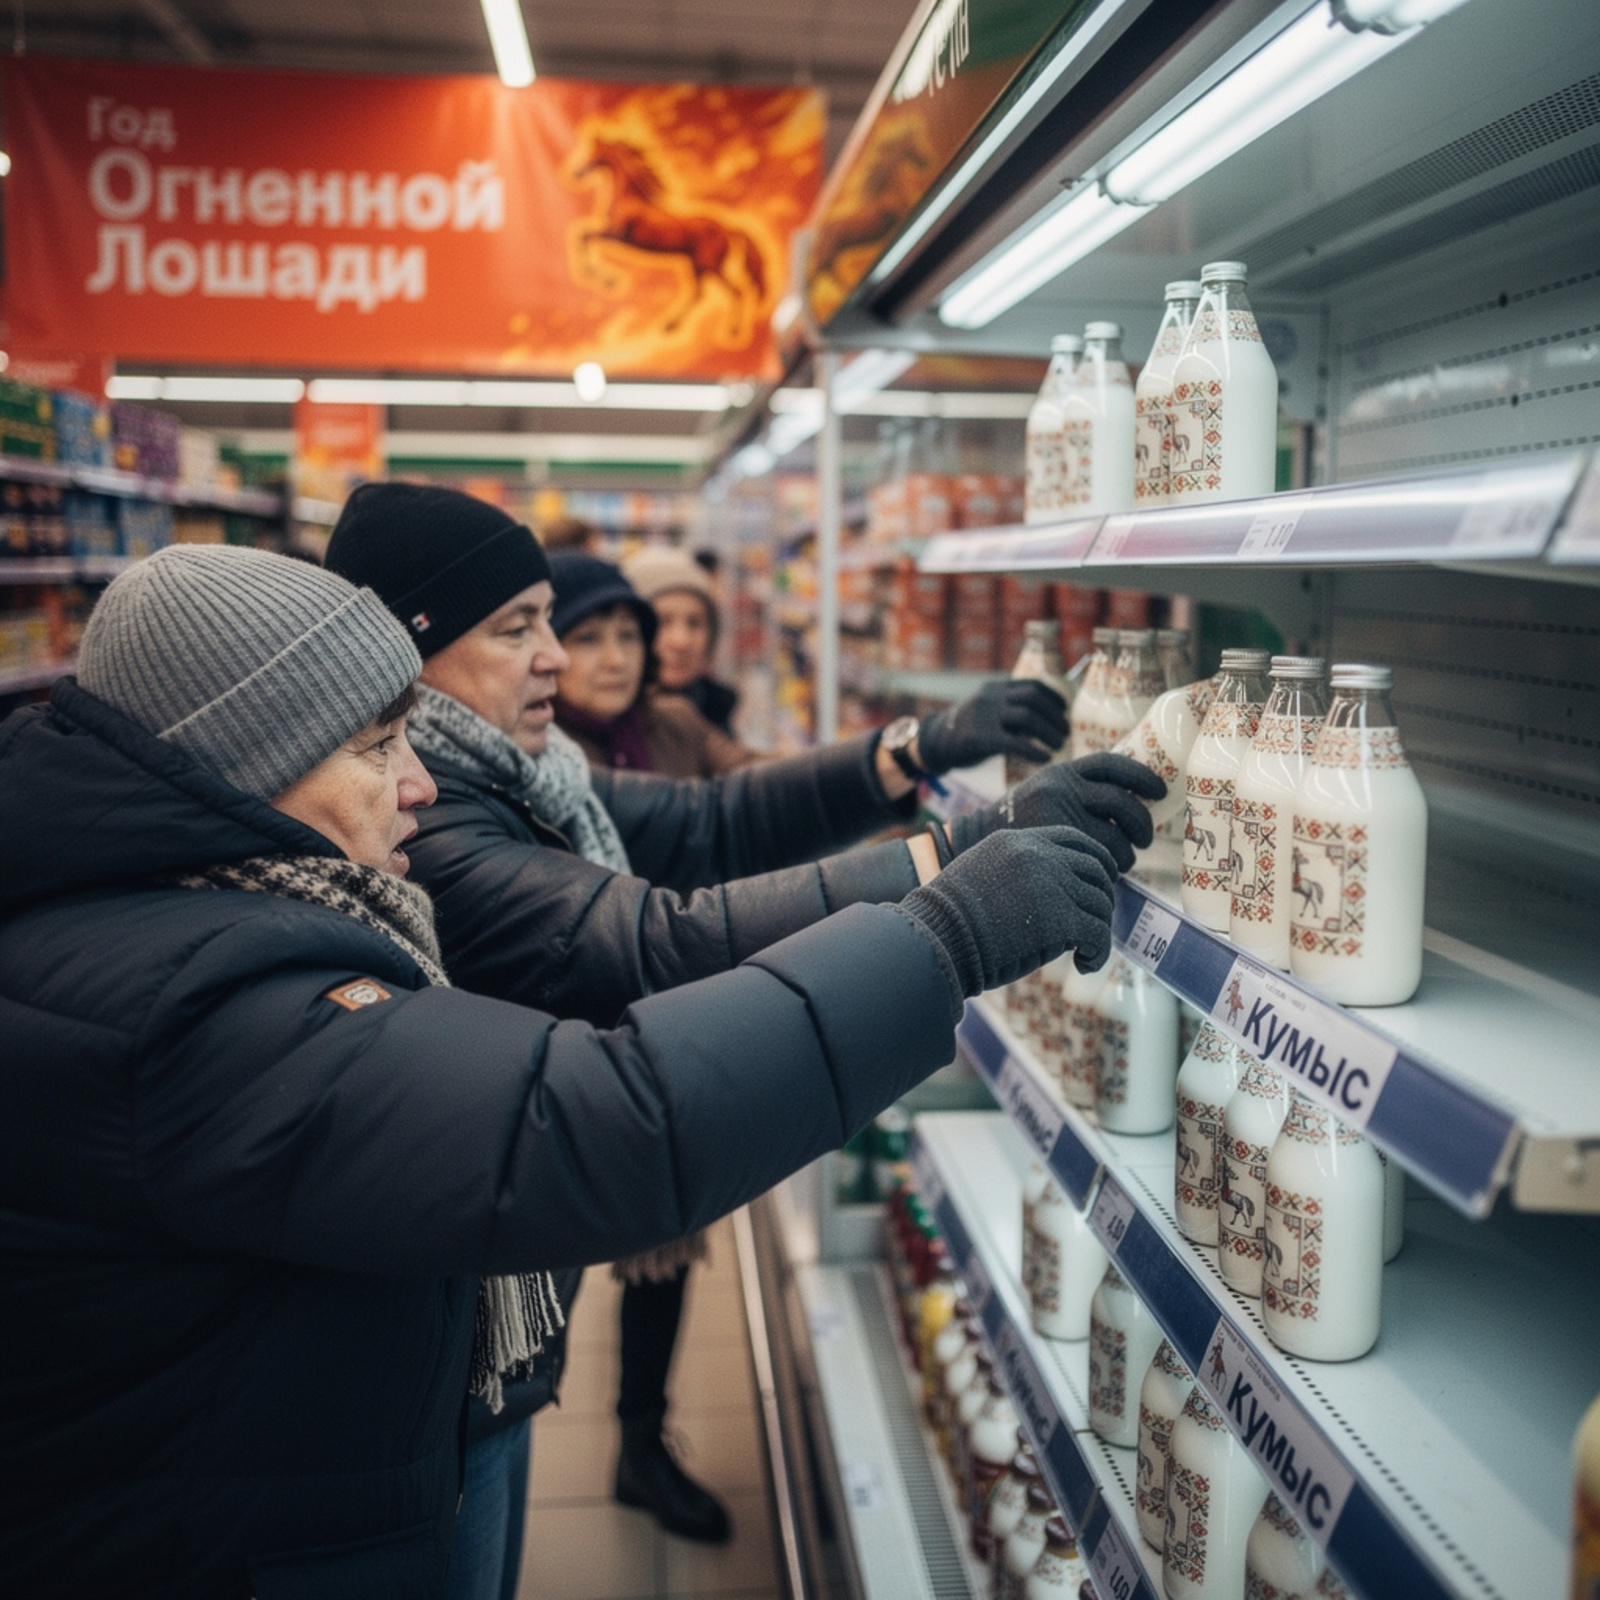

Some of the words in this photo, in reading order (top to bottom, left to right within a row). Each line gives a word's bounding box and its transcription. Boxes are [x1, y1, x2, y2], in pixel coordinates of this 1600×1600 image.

[87, 97, 177, 152] Год
[88, 150, 506, 233] Огненной
[86, 223, 428, 313] Лошади
